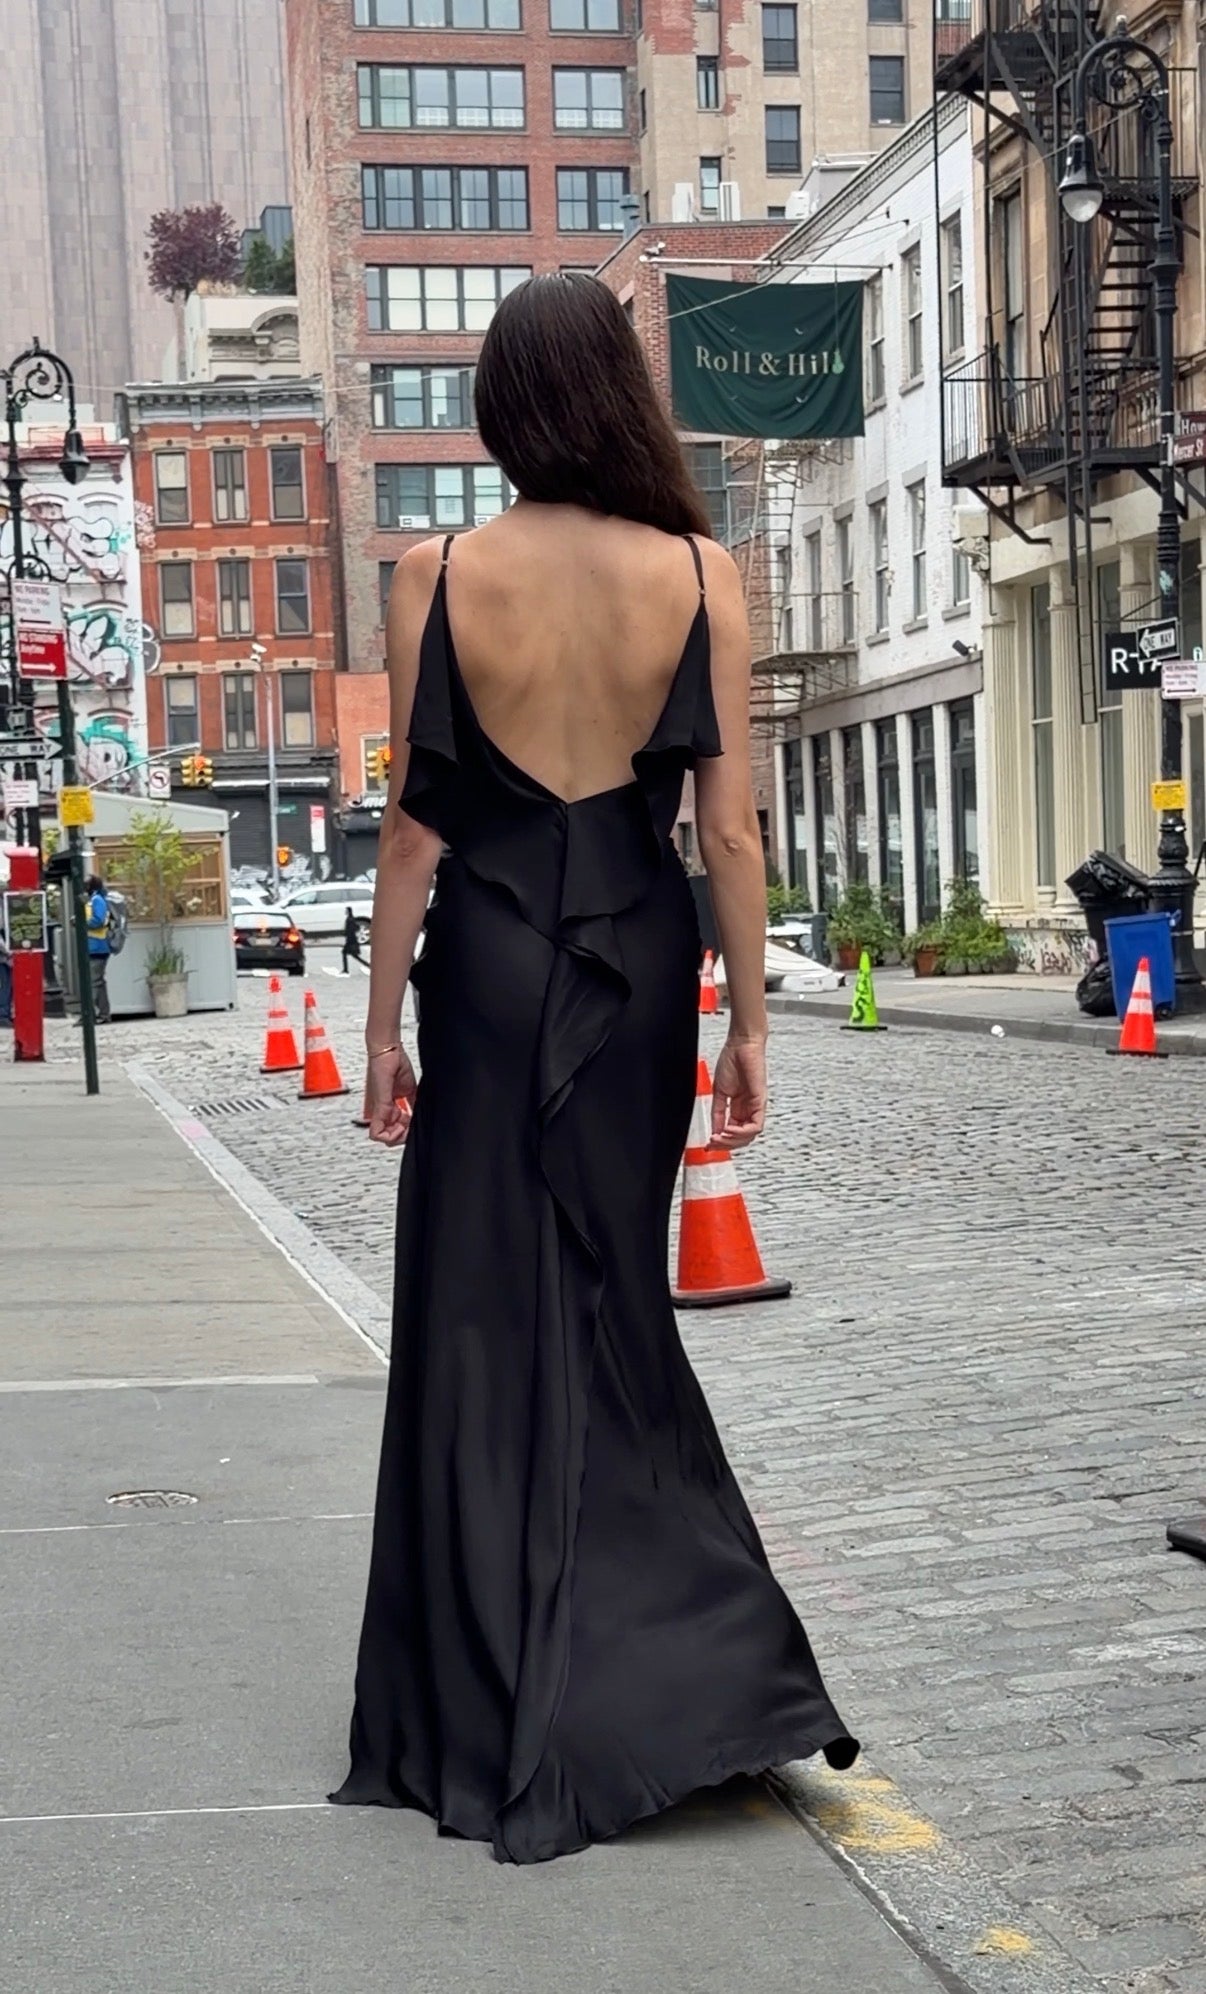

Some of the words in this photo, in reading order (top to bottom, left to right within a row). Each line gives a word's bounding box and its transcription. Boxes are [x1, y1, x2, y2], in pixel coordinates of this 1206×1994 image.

[696, 345, 750, 374] Roll
[758, 352, 781, 376] &
[788, 351, 845, 376] Hil
[1143, 636, 1155, 650] ONE
[1160, 632, 1172, 645] WAY
[29, 744, 52, 753] WAY
